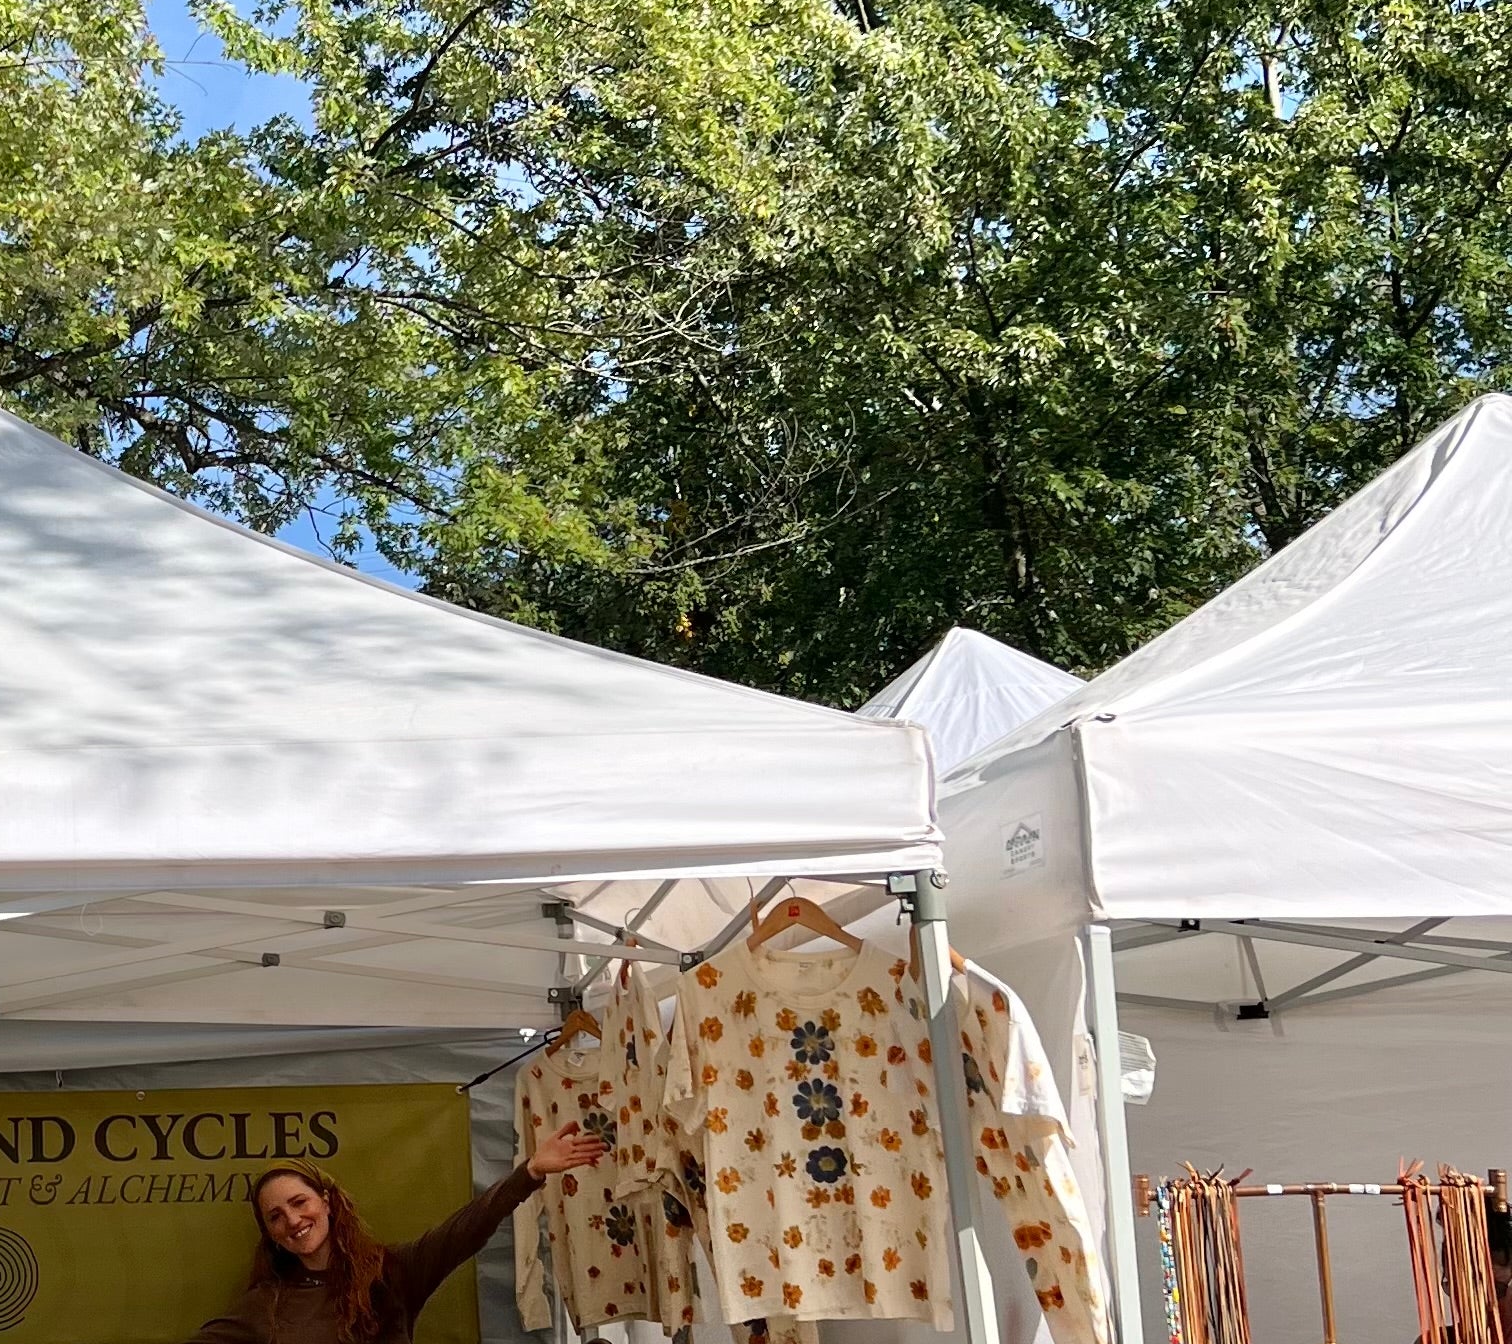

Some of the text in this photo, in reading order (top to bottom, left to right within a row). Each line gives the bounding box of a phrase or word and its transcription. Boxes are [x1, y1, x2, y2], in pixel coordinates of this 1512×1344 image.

[94, 1111, 338, 1161] CYCLES
[29, 1174, 63, 1205] &
[65, 1173, 260, 1205] ALCHEMY
